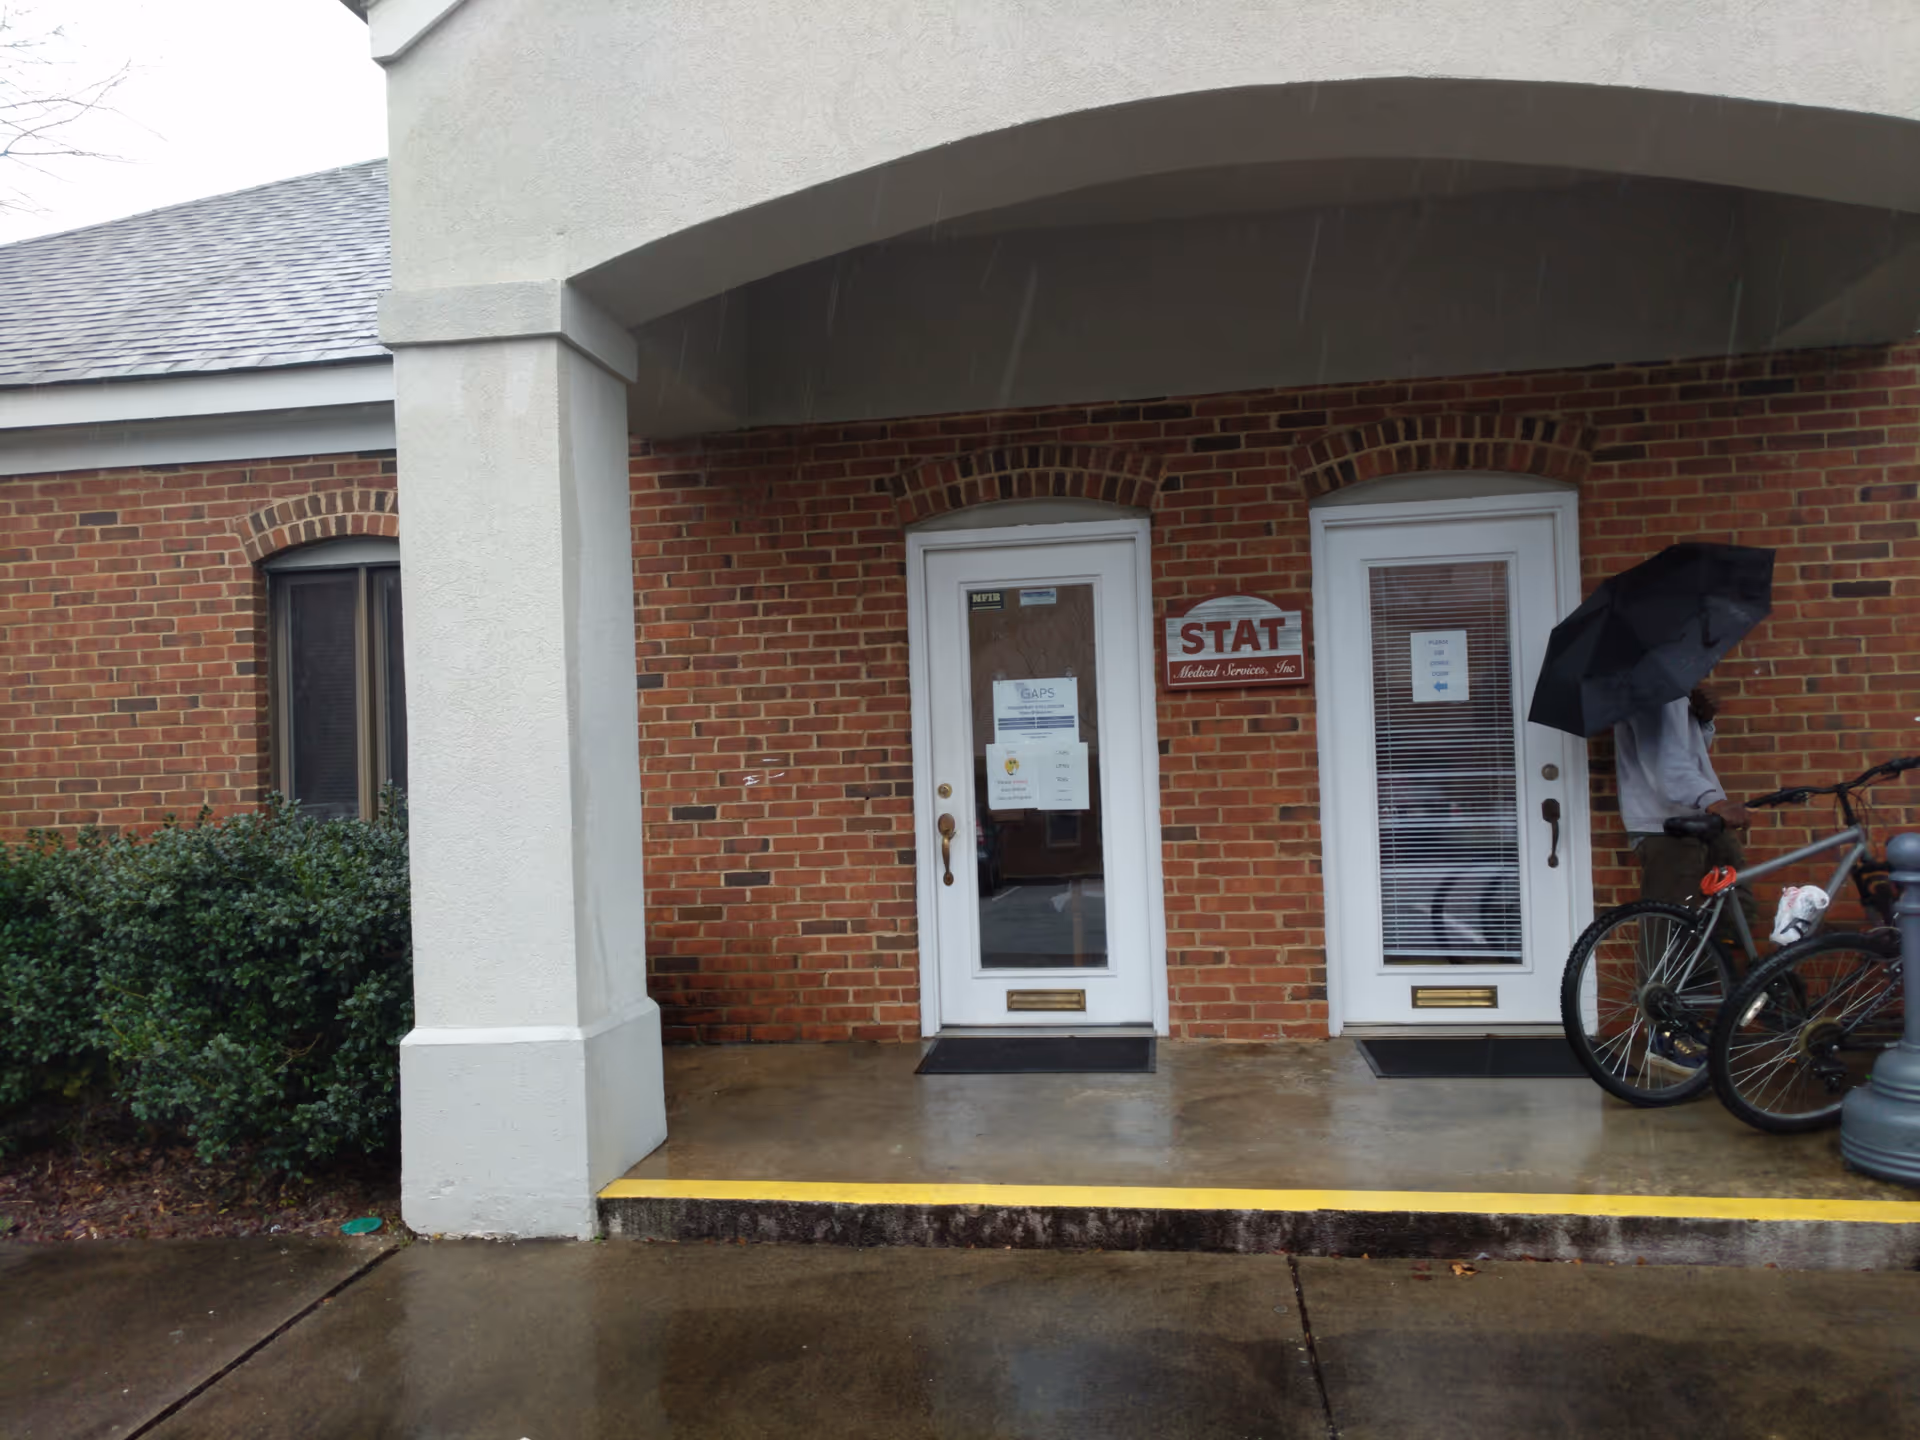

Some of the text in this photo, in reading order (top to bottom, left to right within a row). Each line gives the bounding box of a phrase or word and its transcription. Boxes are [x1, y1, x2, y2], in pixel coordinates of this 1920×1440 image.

[1180, 617, 1286, 655] STAT
[1173, 663, 1220, 679] Medical
[1274, 659, 1297, 674] Inc
[1020, 686, 1056, 700] GAPS
